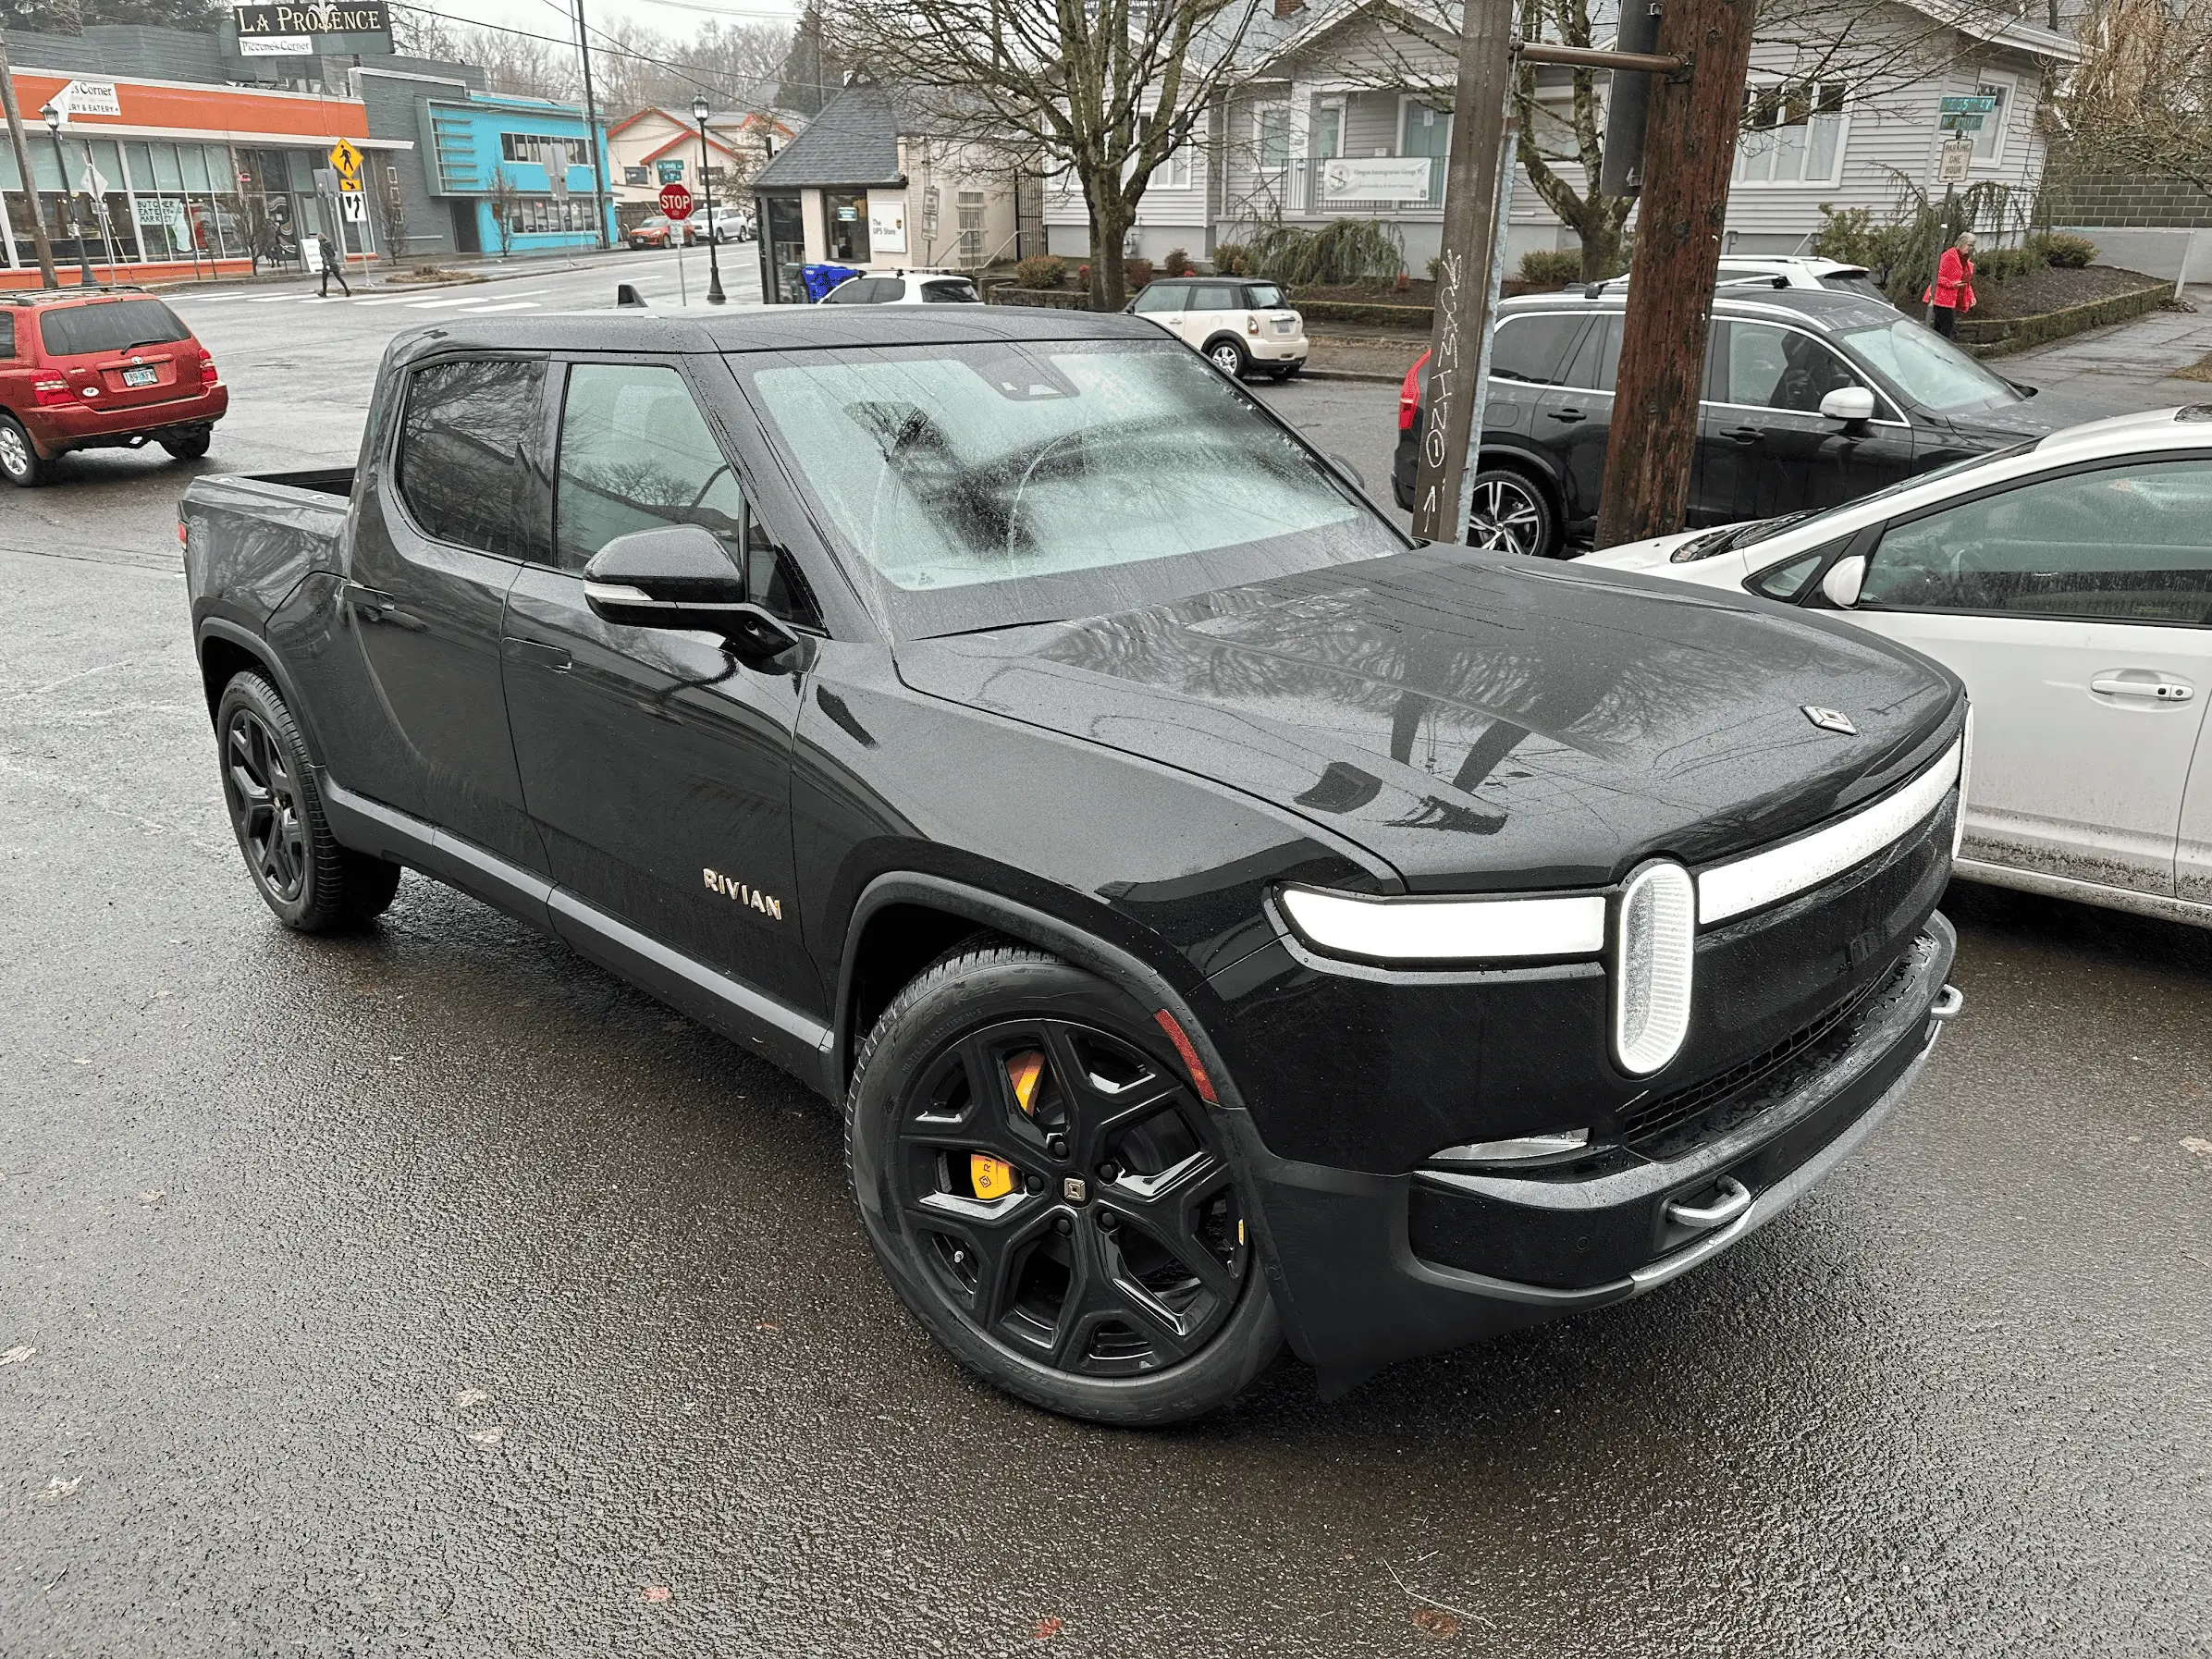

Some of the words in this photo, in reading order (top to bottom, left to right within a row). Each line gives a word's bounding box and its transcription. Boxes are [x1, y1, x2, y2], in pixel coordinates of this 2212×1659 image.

[237, 7, 271, 32] LA
[242, 41, 279, 52] Piccone's
[280, 40, 310, 52] Corner
[80, 82, 112, 96] Corner
[88, 104, 114, 113] EATERY
[1945, 143, 1971, 153] PARKING
[1948, 154, 1962, 164] ONE
[1945, 166, 1962, 175] HOUR
[661, 194, 691, 210] STOP
[872, 218, 882, 227] The
[703, 868, 782, 920] RIVIAN
